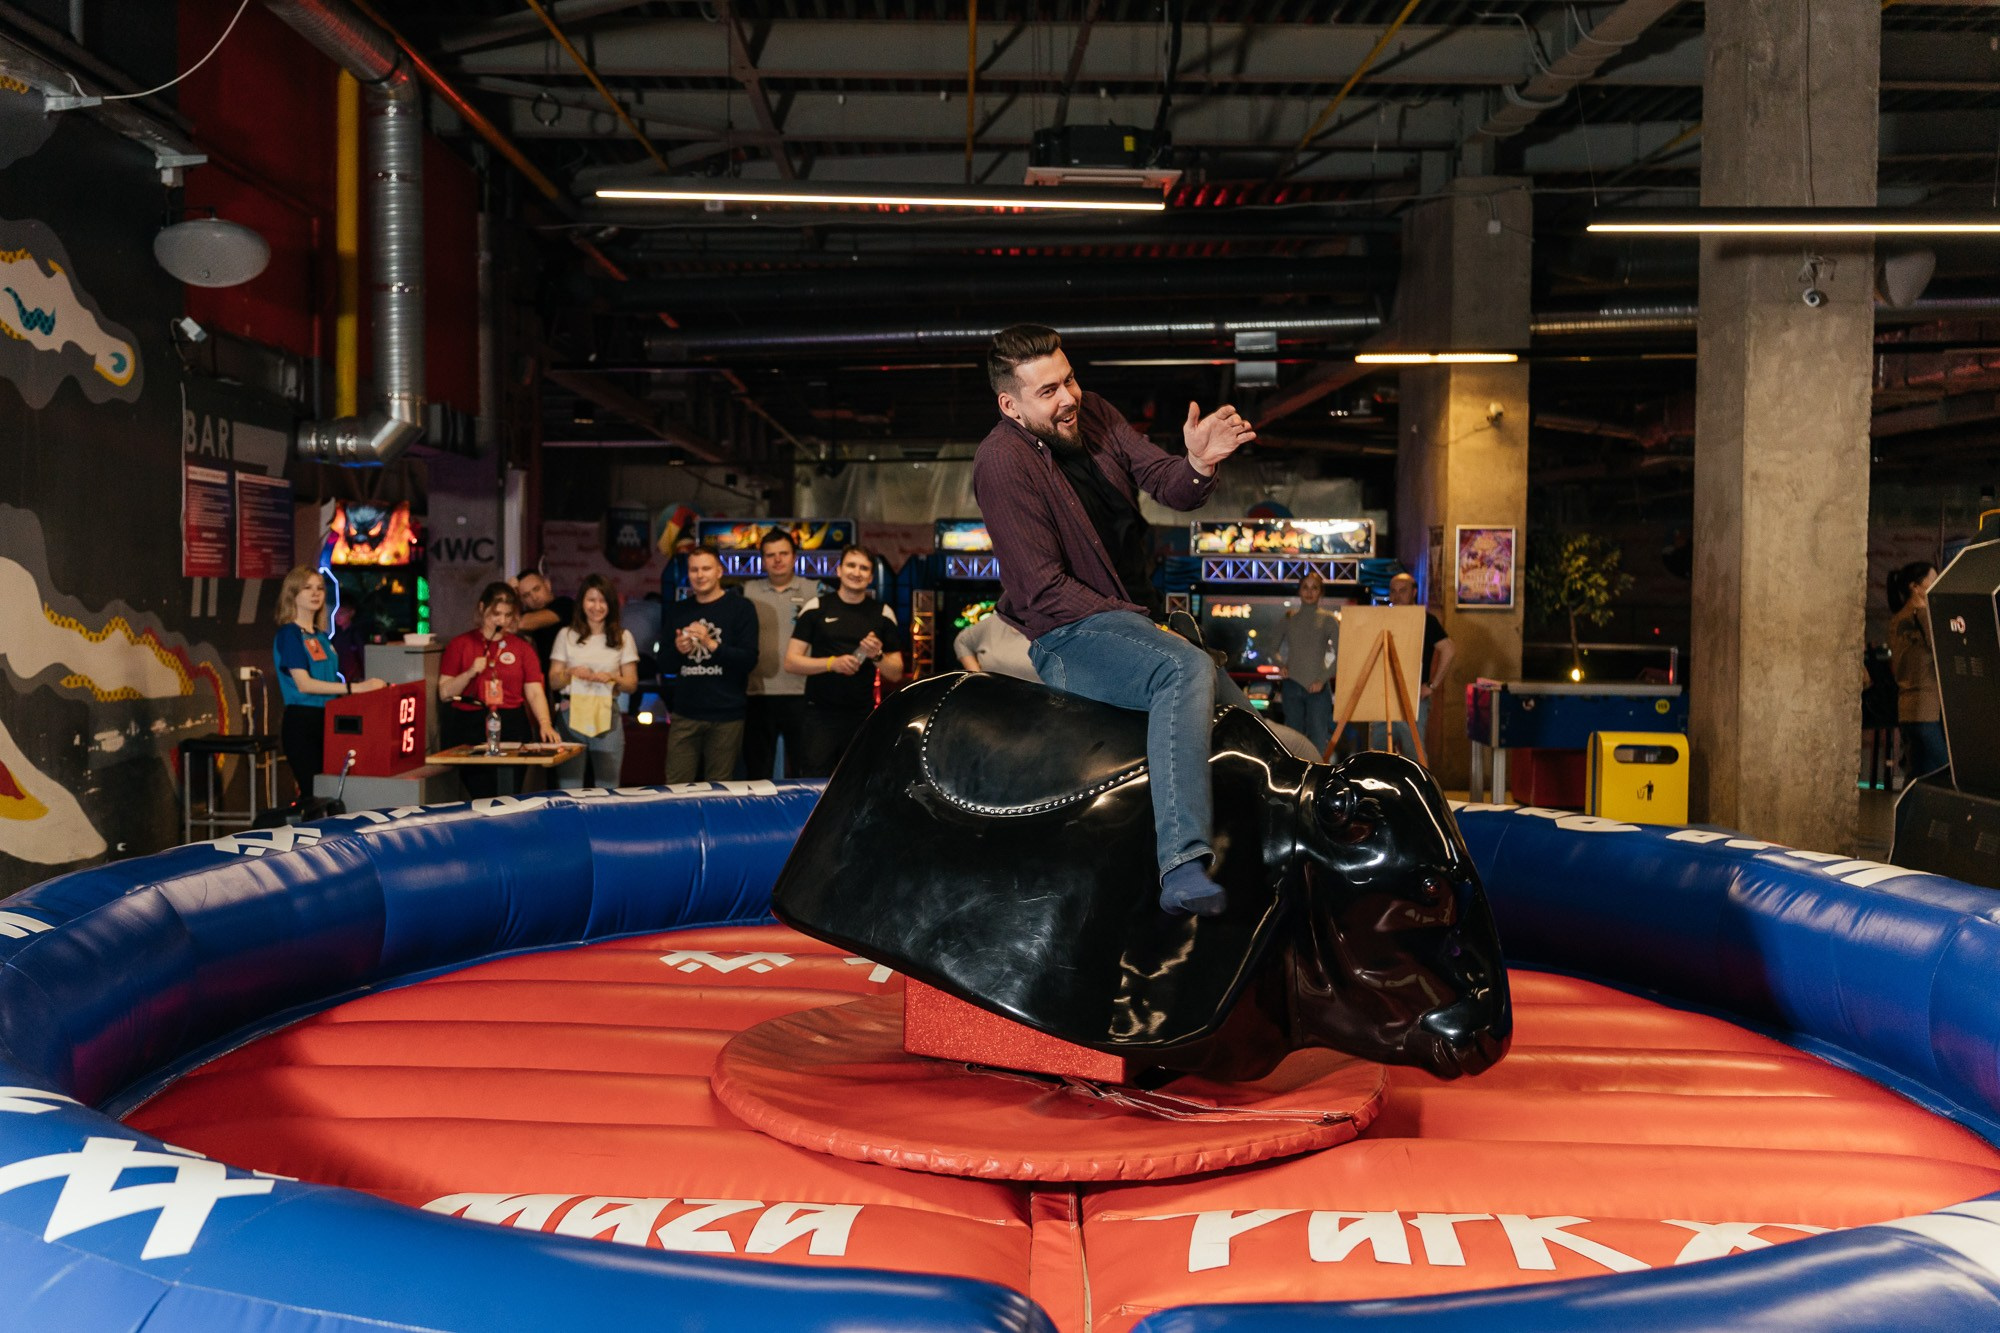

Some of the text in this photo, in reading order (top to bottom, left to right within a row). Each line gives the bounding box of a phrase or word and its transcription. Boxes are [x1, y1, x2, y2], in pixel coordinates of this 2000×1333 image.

[185, 409, 230, 459] BAR
[448, 537, 495, 562] WC
[400, 697, 415, 724] 03
[402, 727, 415, 752] 15
